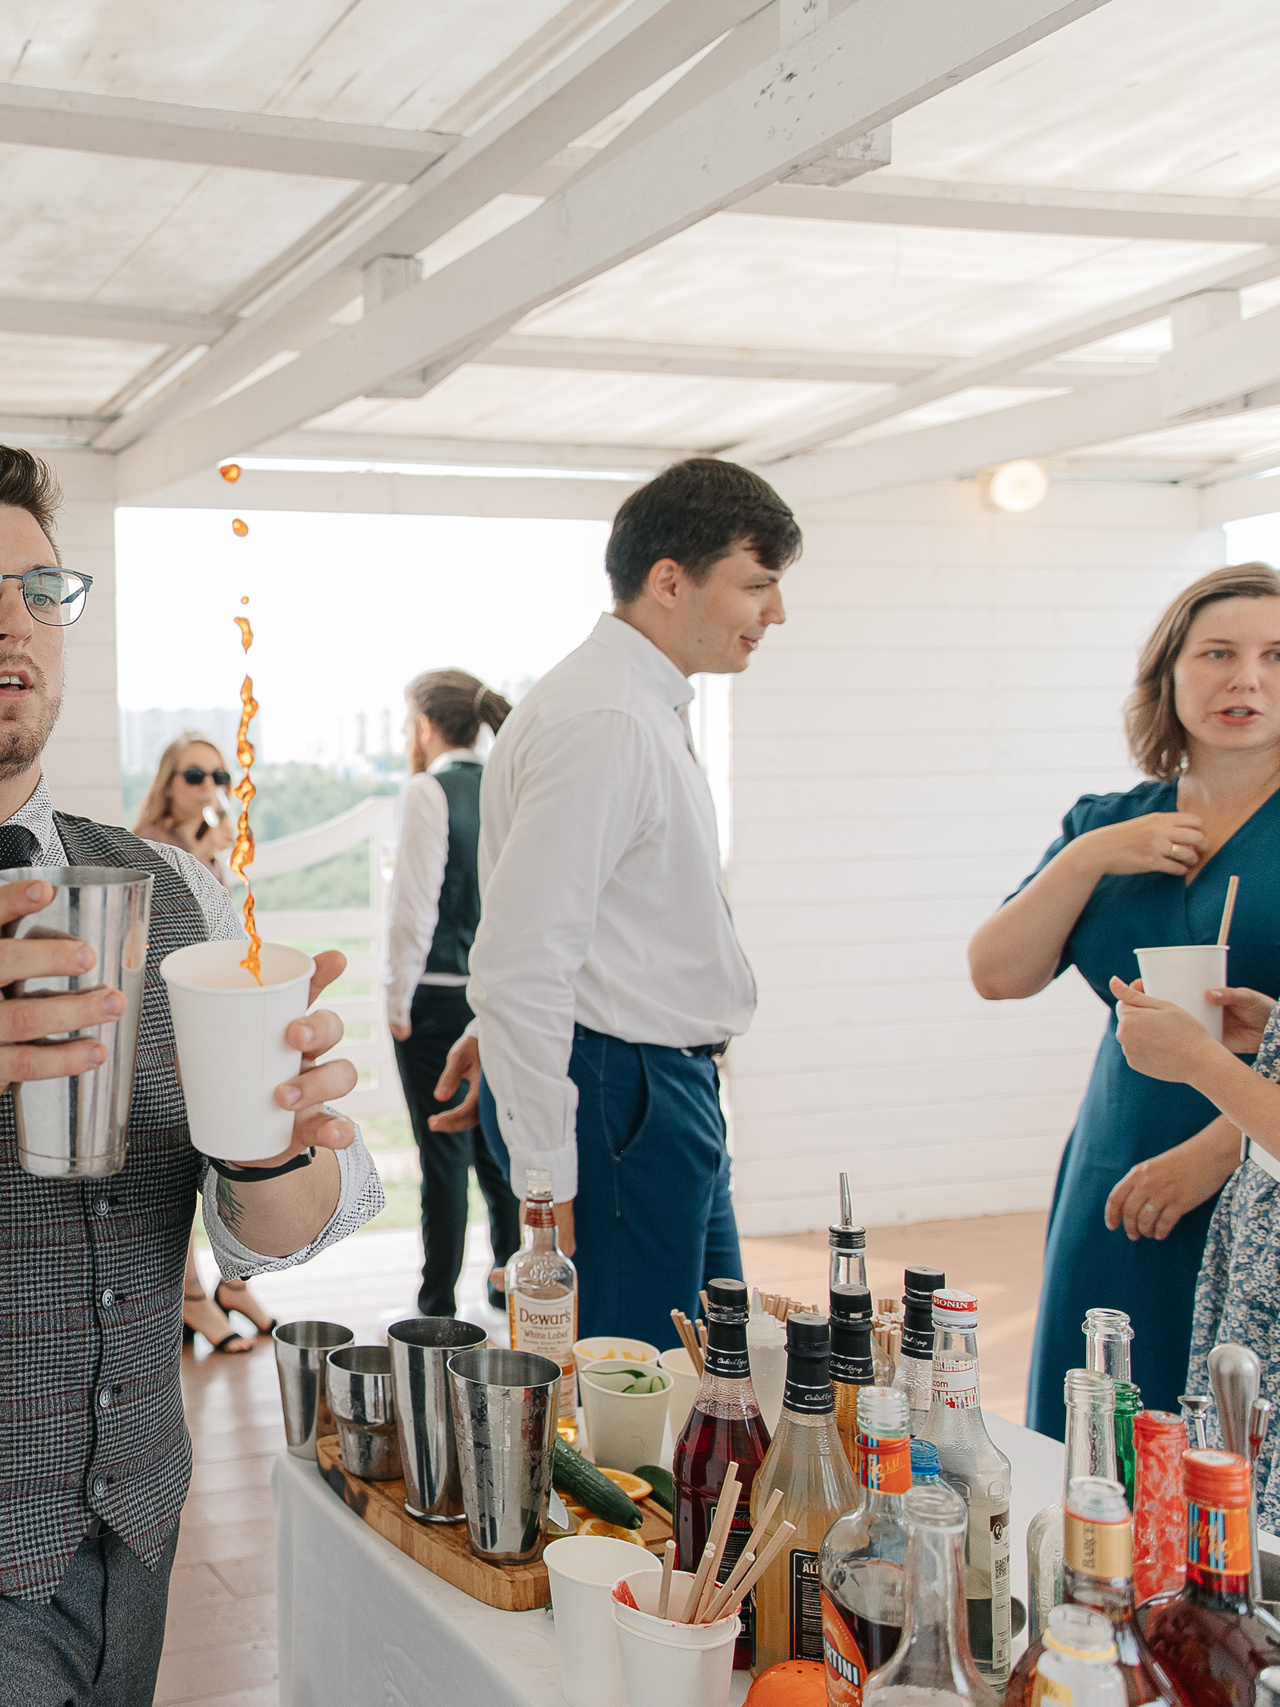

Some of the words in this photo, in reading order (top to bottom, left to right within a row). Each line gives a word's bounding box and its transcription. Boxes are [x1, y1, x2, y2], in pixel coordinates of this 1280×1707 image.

[933, 1296, 968, 1309] MONIN
[519, 1308, 572, 1325] Dewar's
[1082, 1523, 1095, 1569] BARCE
